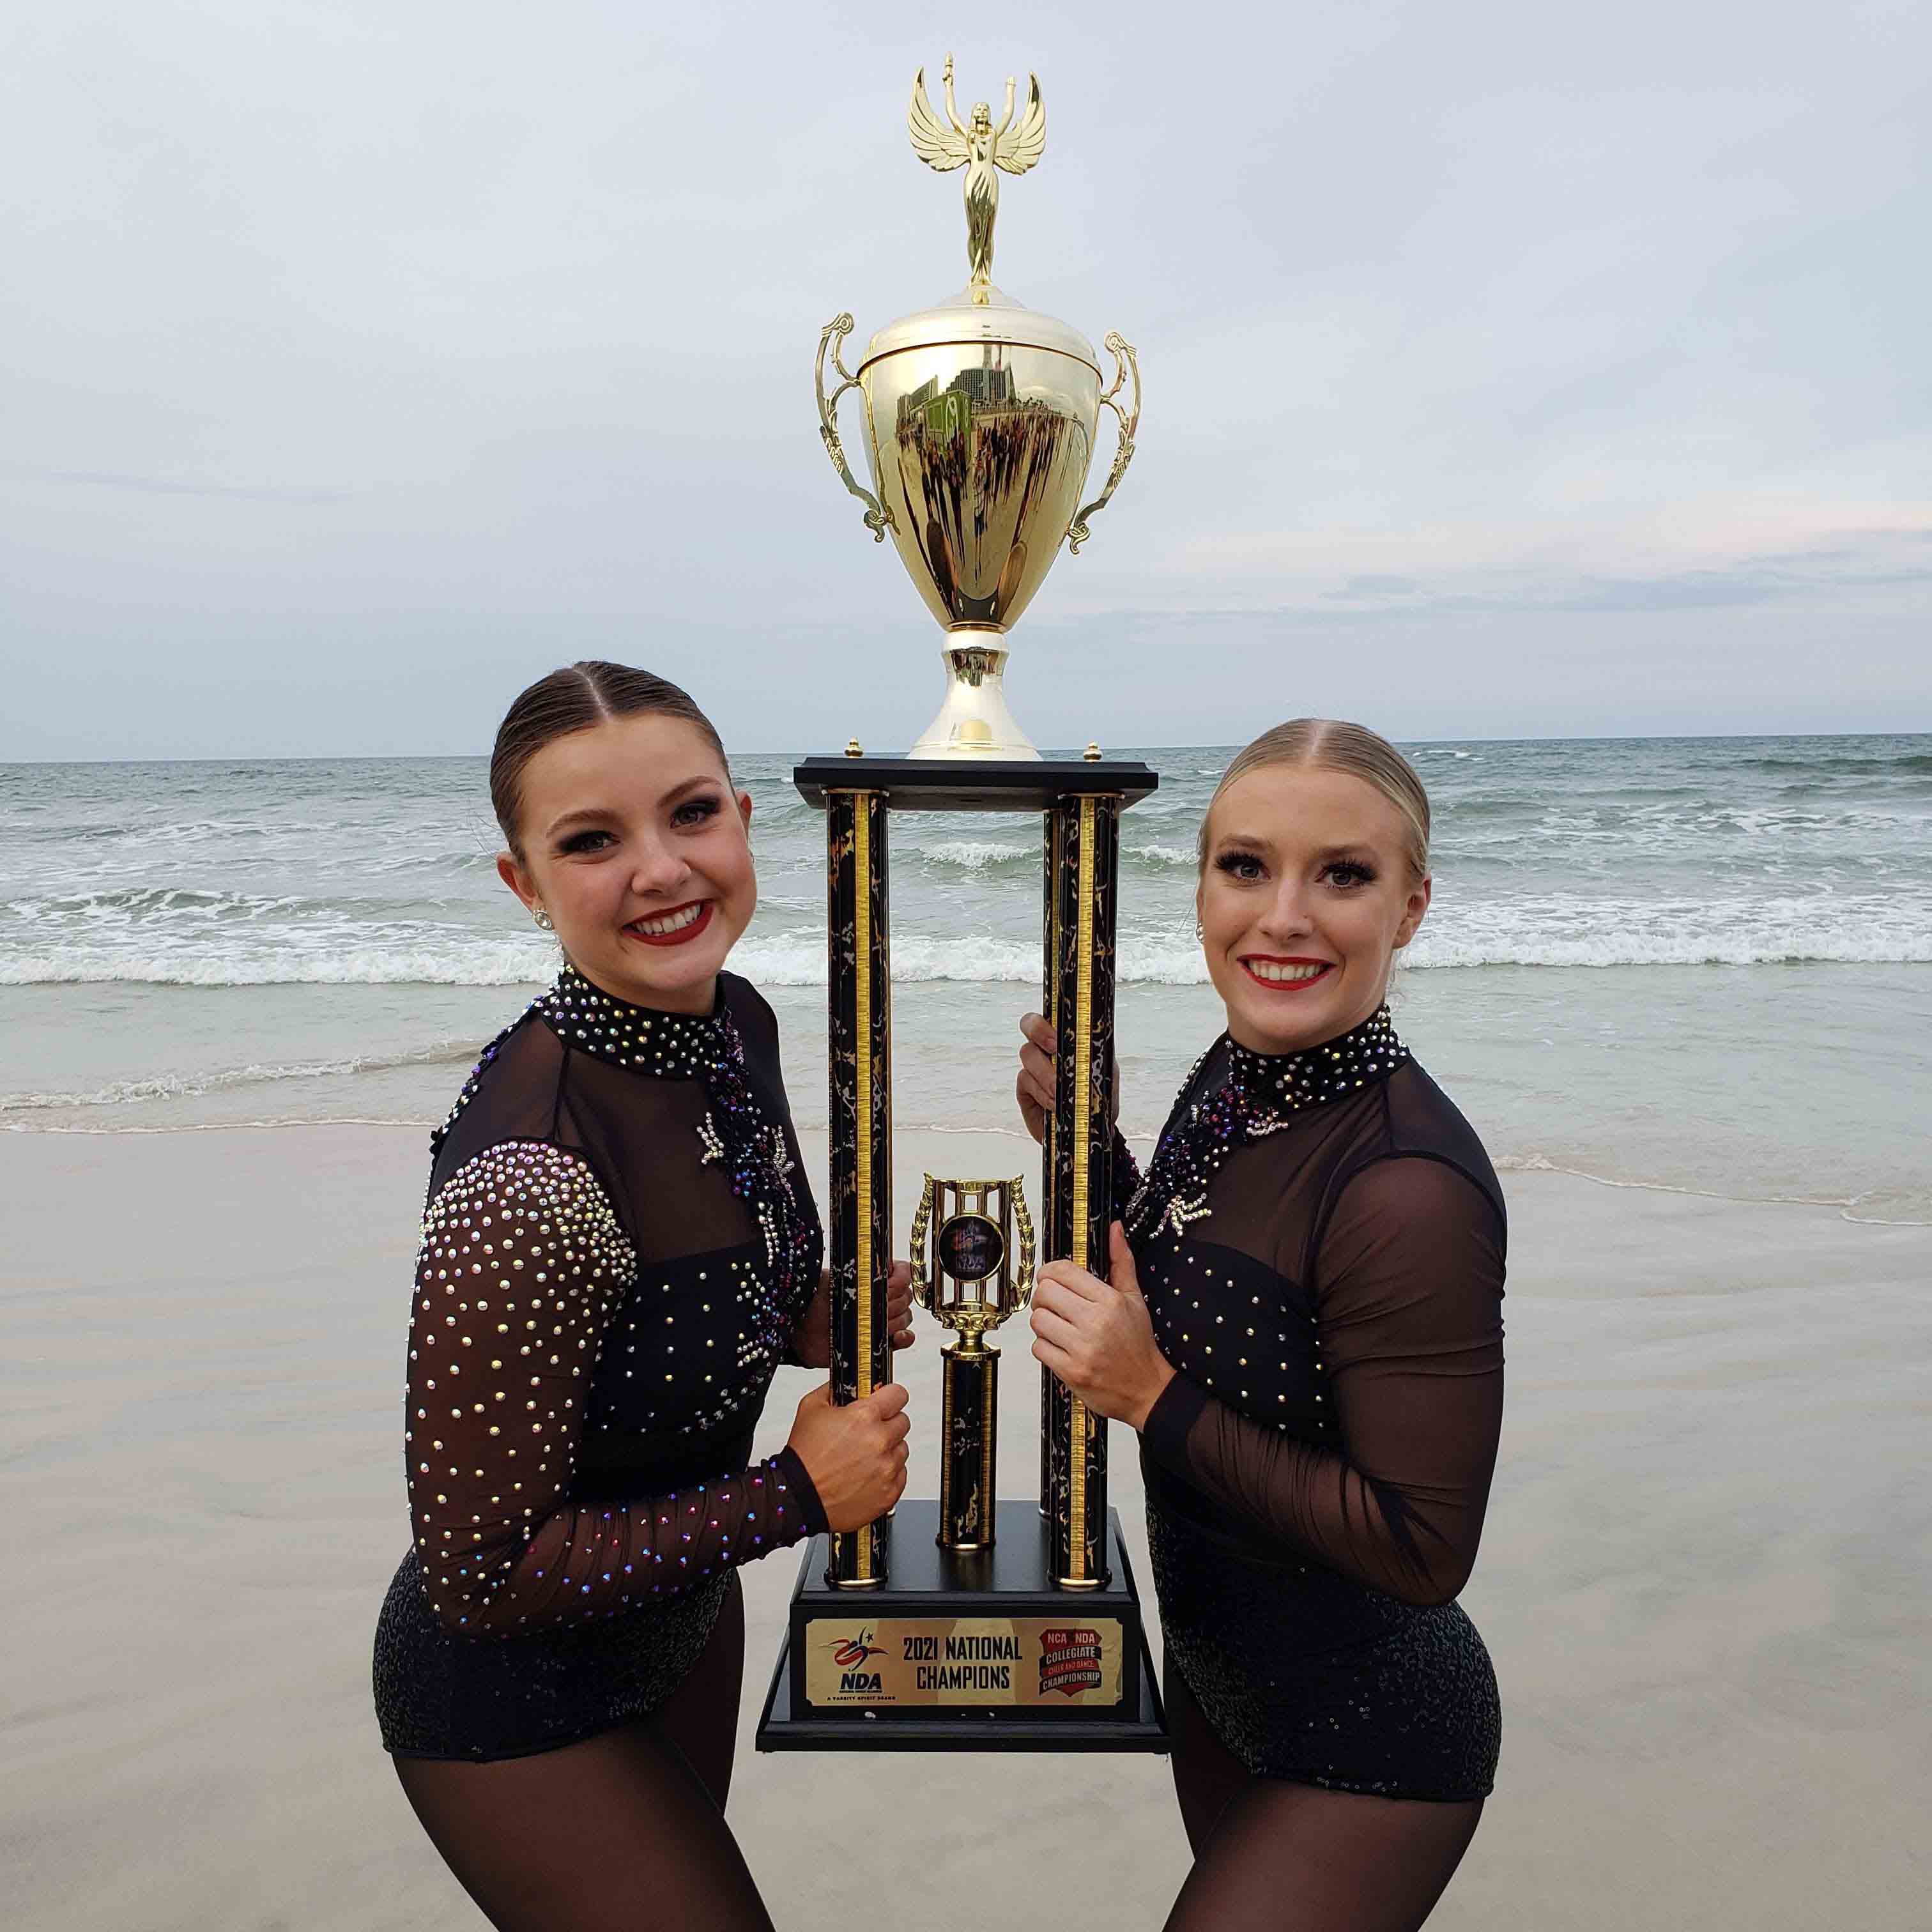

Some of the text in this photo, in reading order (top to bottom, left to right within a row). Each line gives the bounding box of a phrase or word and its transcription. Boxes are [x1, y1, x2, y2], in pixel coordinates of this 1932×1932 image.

[903, 1636, 1023, 1660] 2021 NATIONAL
[1047, 1633, 1095, 1644] NCA NDA
[1046, 1646, 1095, 1665] COLLEGIATE
[840, 1673, 882, 1690] NDA
[917, 1666, 1010, 1690] CHAMPIONS
[1043, 1671, 1100, 1690] CHAMPIONSHIP
